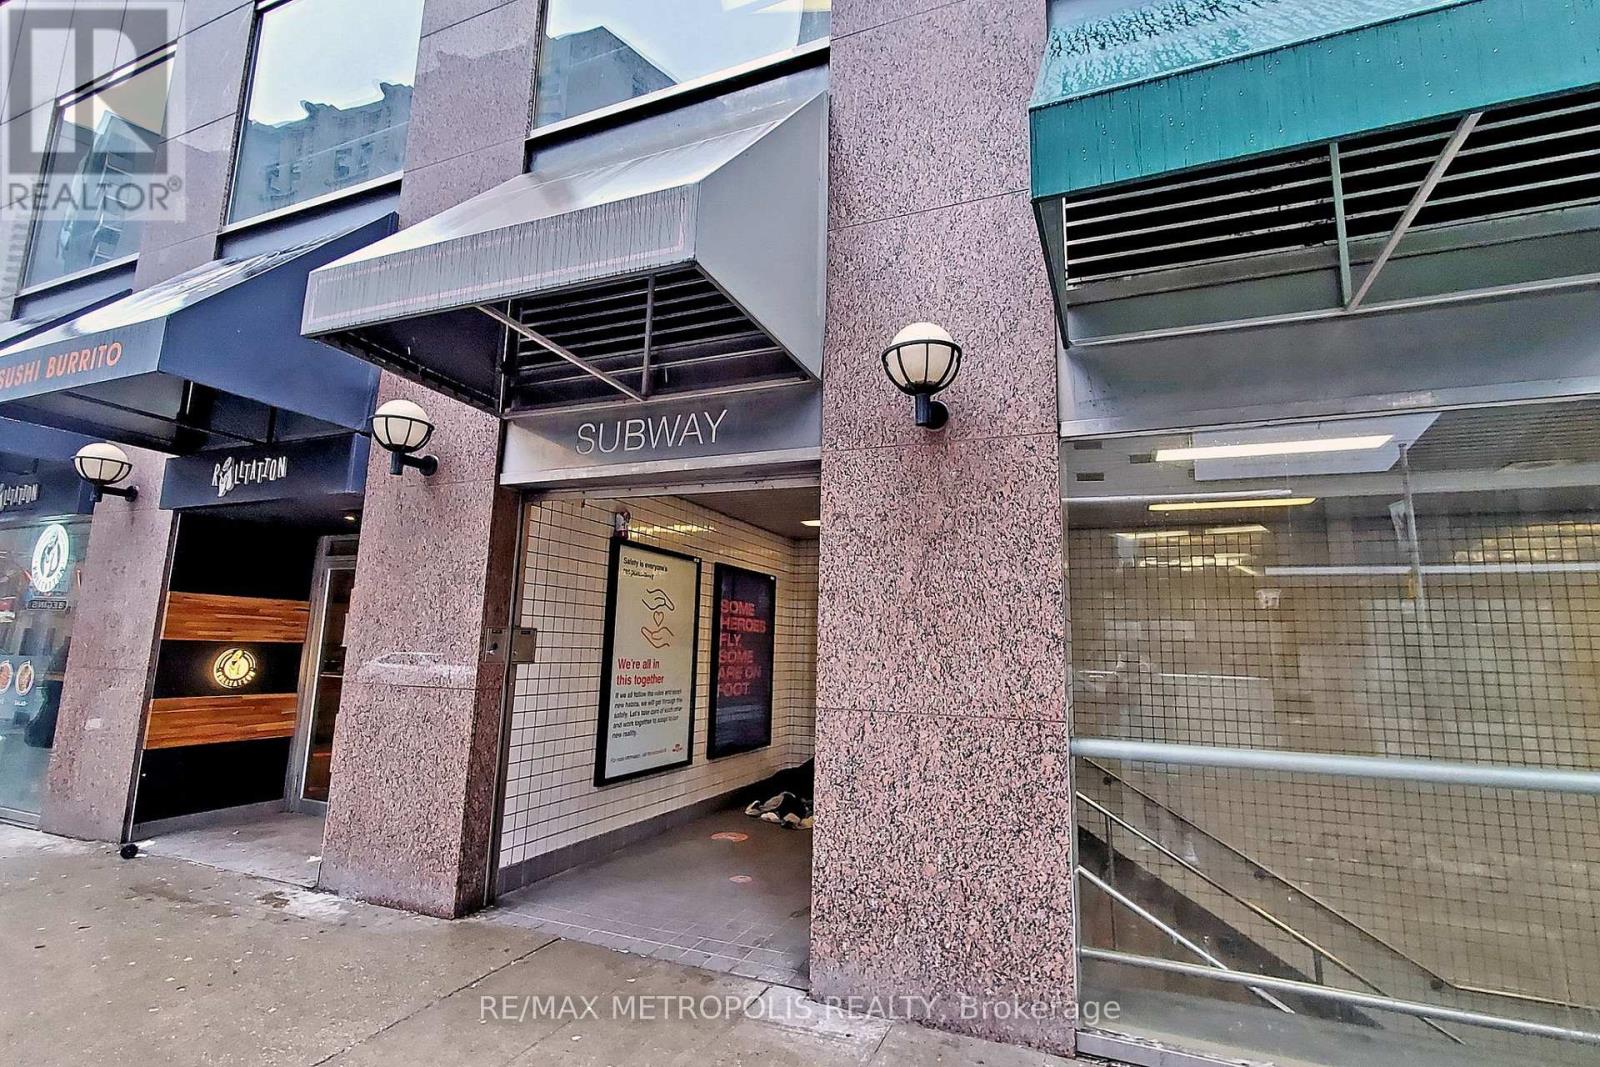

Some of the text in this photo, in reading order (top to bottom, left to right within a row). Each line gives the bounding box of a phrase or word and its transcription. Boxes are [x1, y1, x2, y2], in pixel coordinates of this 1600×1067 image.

[46, 342, 122, 378] BURRITO
[575, 409, 727, 455] SUBWAY
[720, 599, 755, 616] SOME
[618, 658, 660, 669] We're all in
[616, 673, 664, 687] this together
